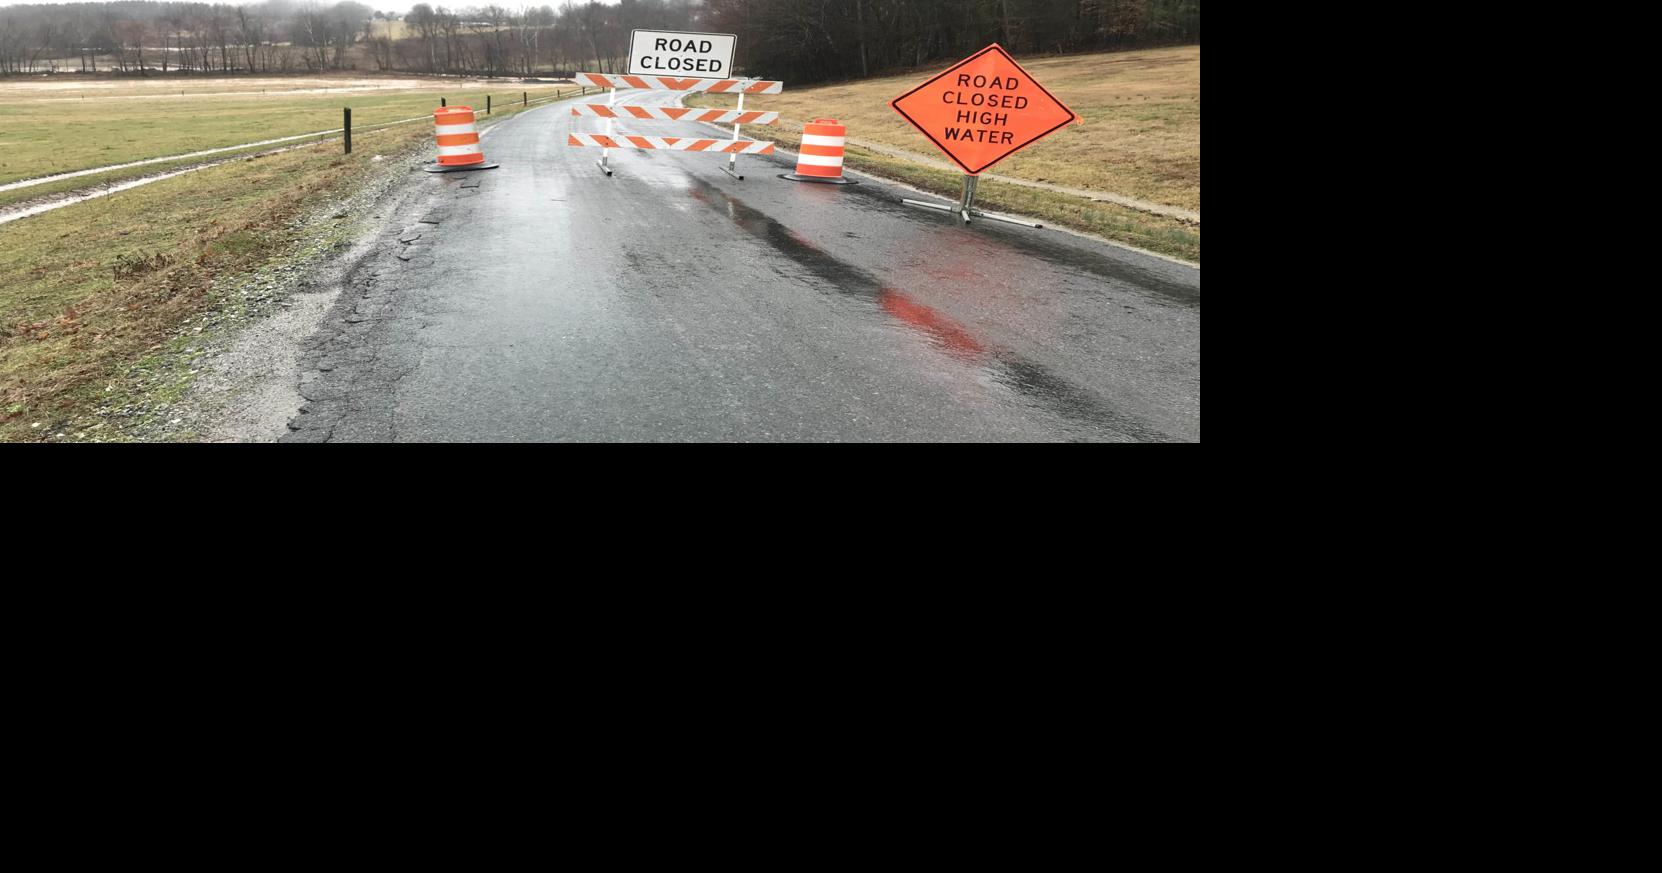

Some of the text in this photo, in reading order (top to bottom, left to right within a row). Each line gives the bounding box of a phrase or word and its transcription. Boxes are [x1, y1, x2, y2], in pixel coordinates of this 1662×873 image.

[654, 37, 713, 54] ROAD
[640, 55, 722, 73] CLOSED
[957, 73, 1019, 90] ROAD
[942, 91, 1028, 109] CLOSED
[957, 110, 1008, 126] HIGH
[945, 127, 1015, 144] WATER
